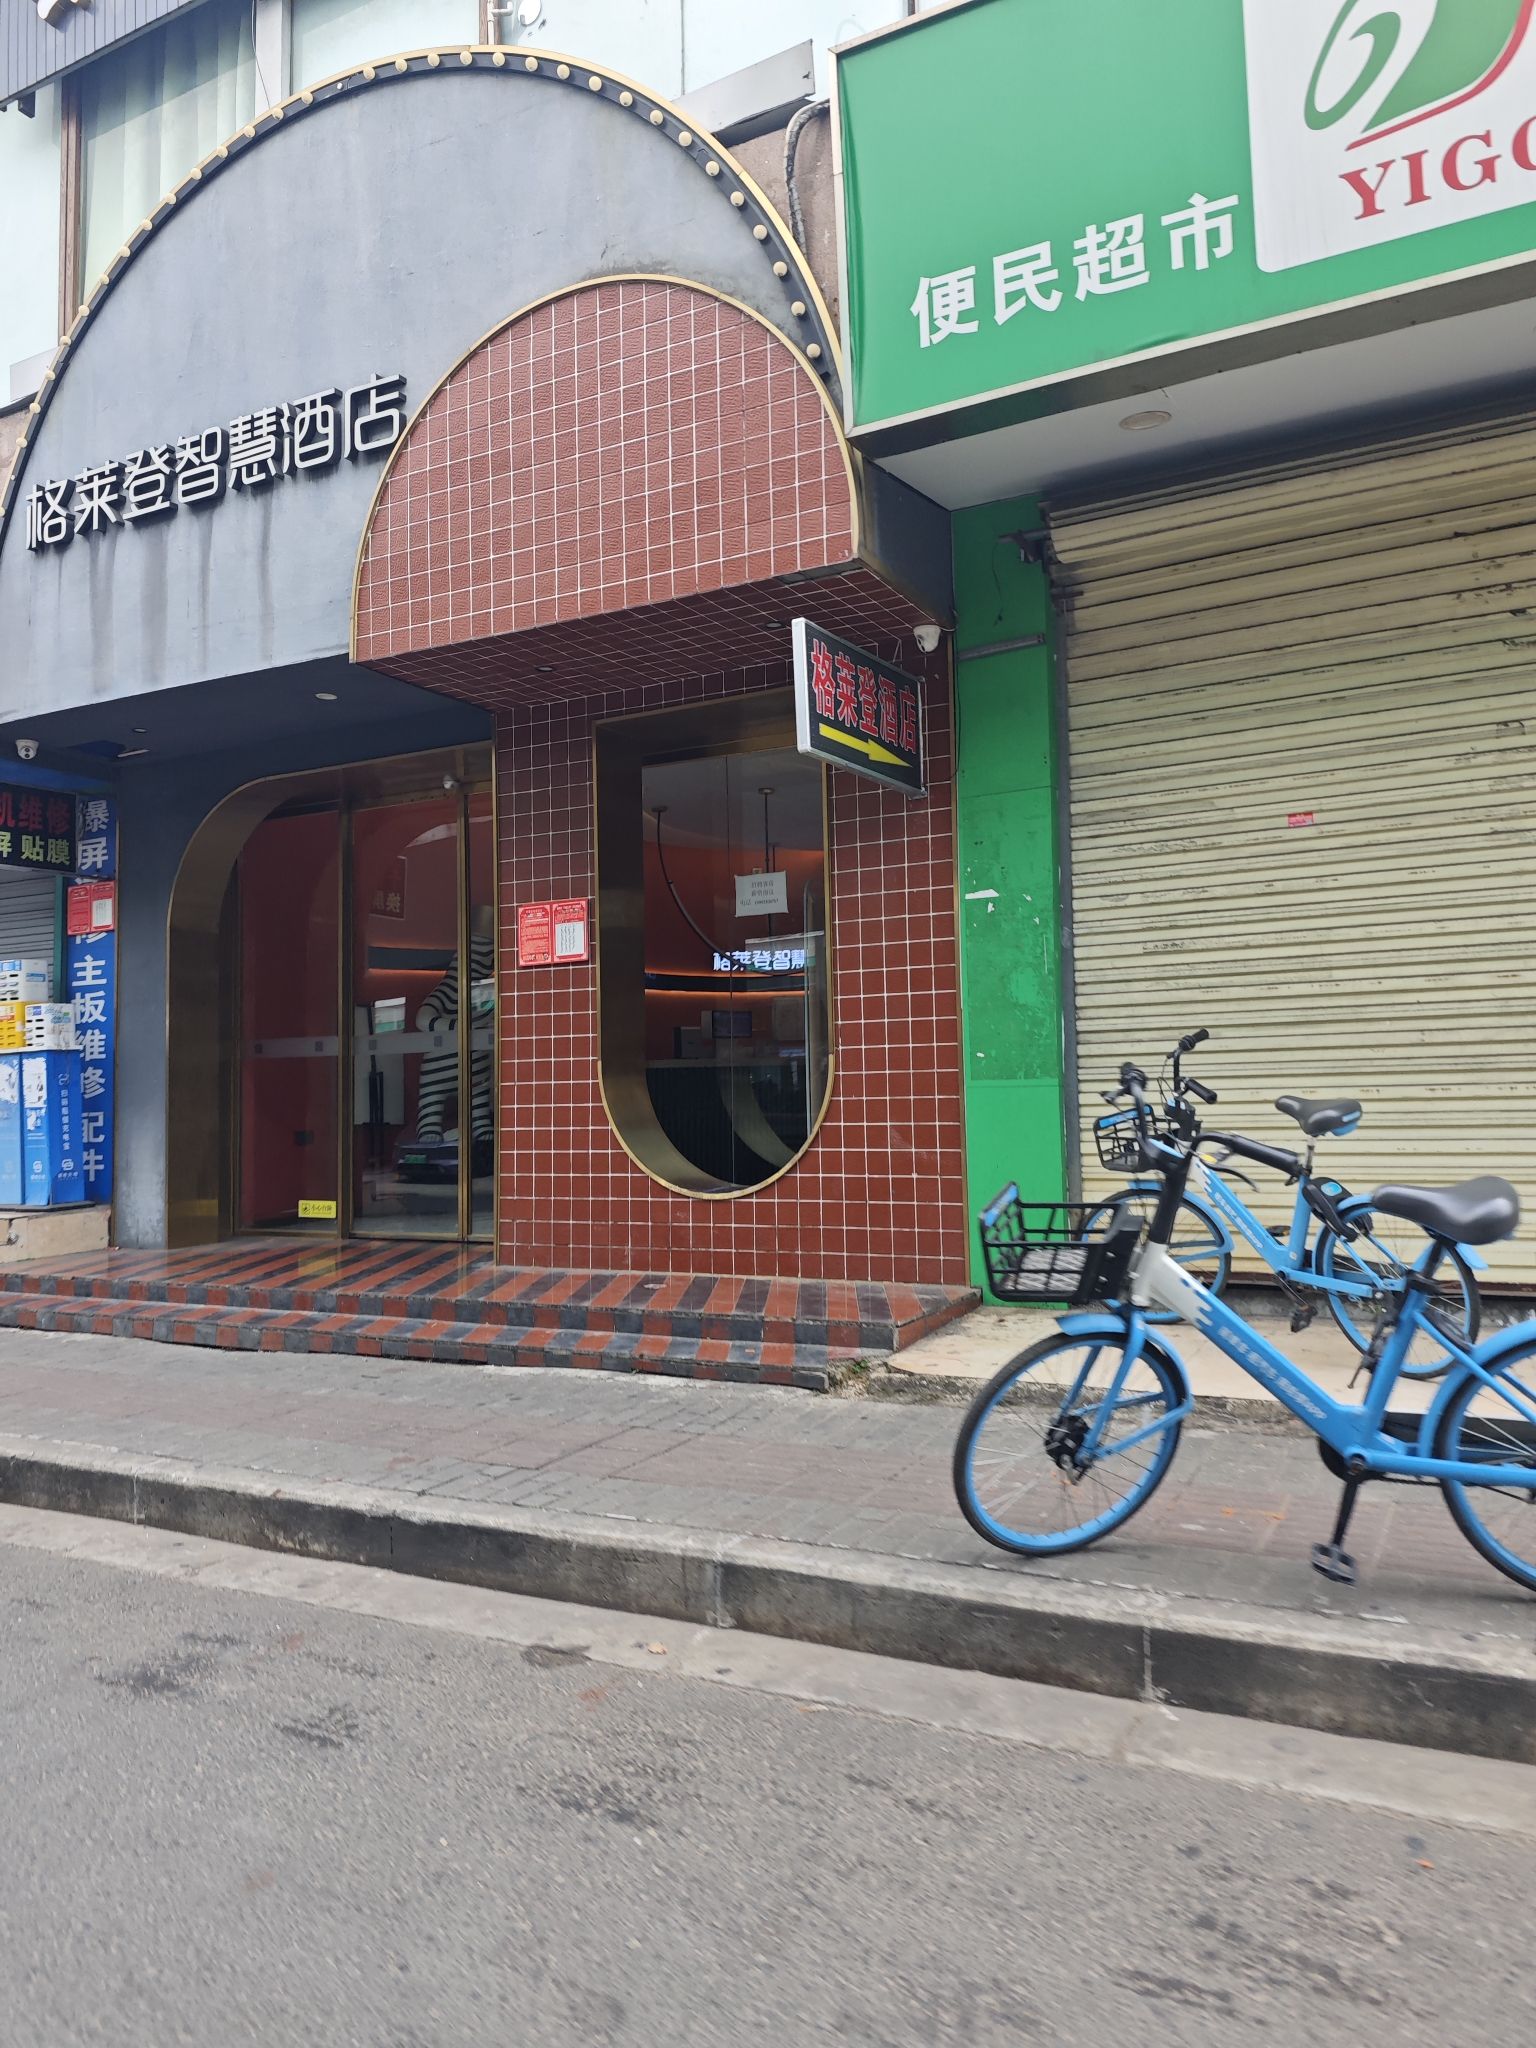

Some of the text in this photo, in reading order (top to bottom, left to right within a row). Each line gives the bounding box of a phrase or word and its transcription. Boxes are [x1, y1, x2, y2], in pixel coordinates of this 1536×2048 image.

[910, 192, 1239, 348] 便民超市
[26, 373, 407, 552] 格莱登智慧酒店
[810, 638, 917, 754] 格莱登酒店
